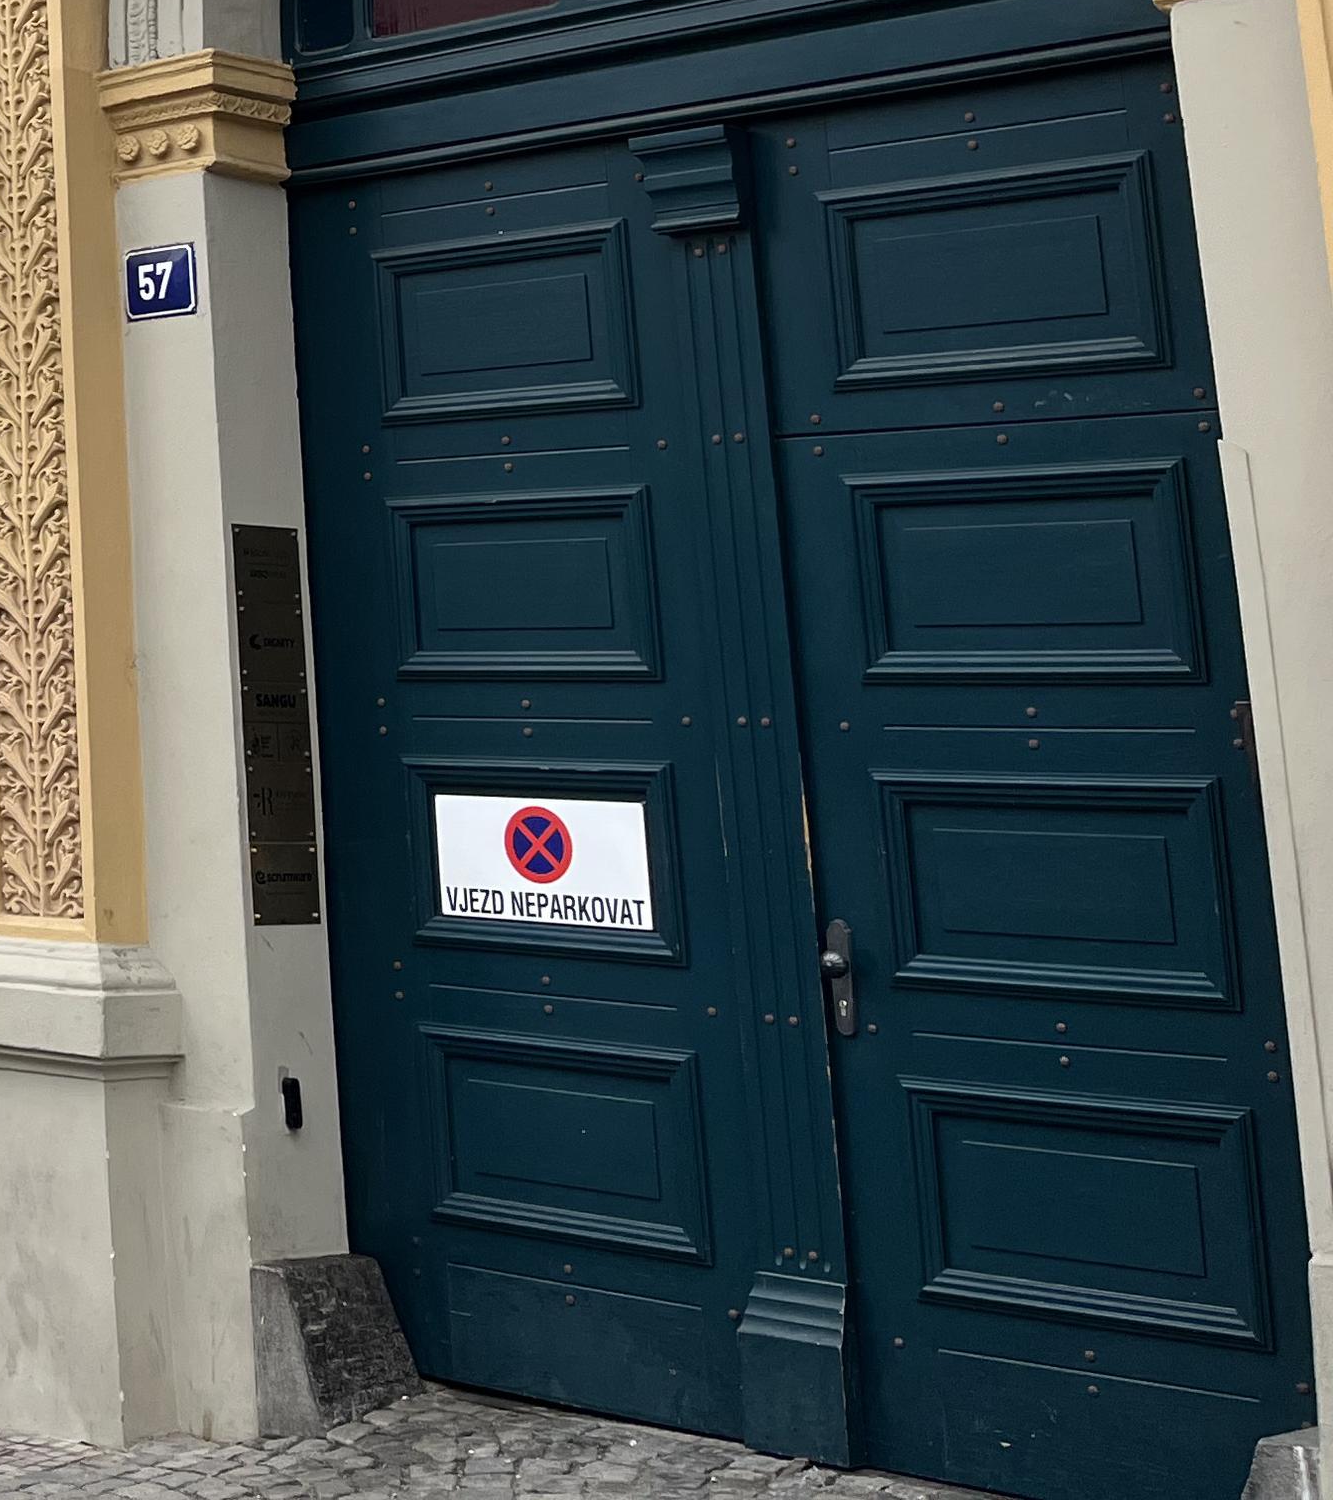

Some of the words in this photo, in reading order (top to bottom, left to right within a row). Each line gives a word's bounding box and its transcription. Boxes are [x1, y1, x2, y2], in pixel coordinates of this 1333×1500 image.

[138, 261, 173, 301] 57
[256, 693, 296, 708] SANGU
[446, 886, 504, 915] VJEZD
[511, 891, 645, 926] NEPARKOVAT
